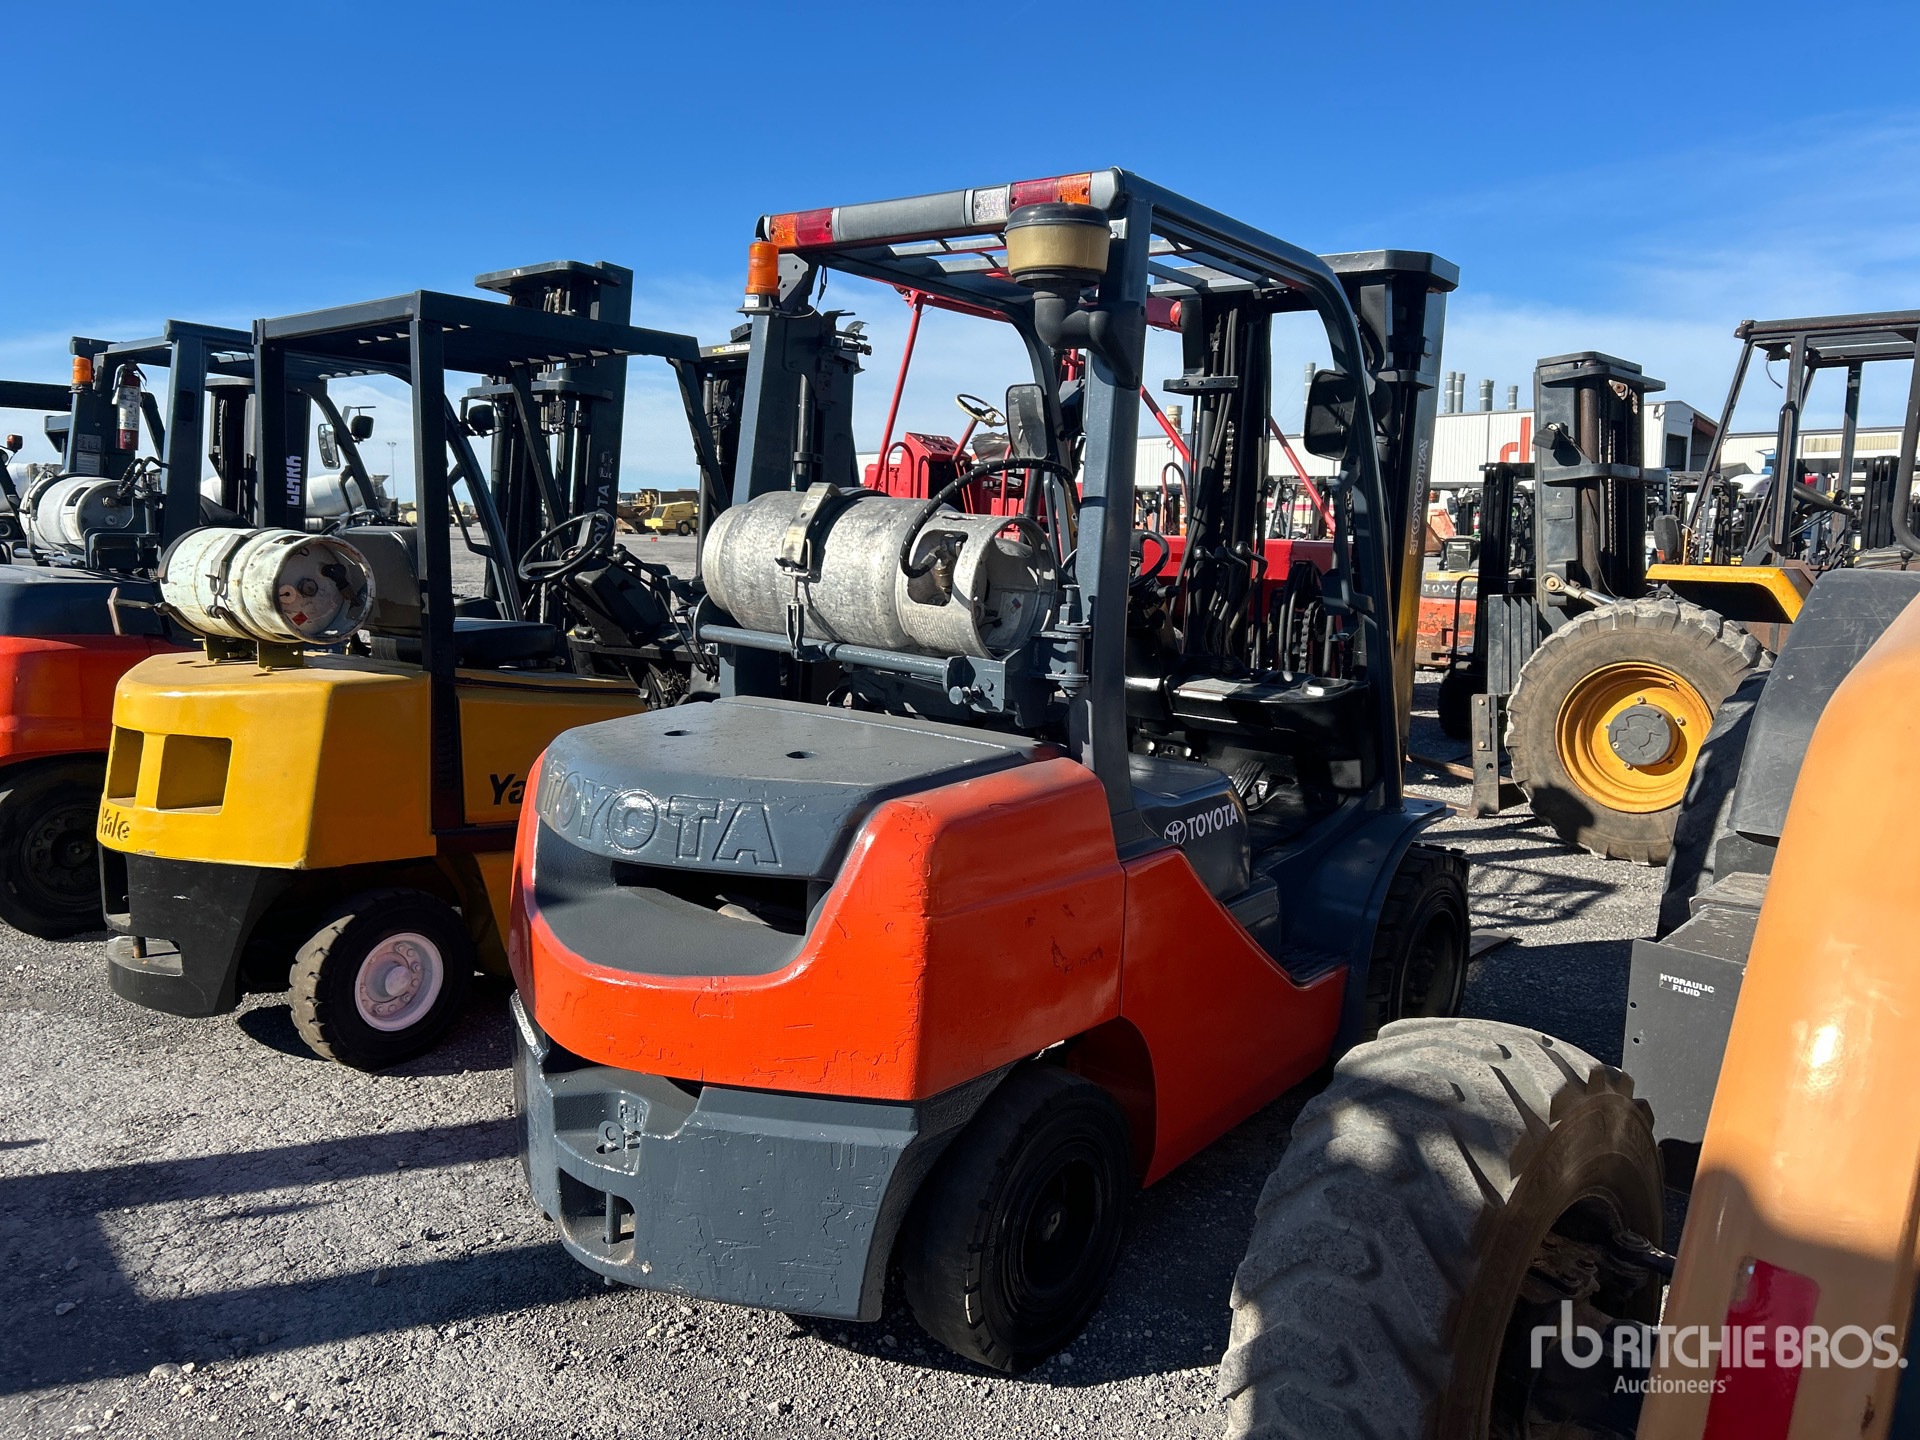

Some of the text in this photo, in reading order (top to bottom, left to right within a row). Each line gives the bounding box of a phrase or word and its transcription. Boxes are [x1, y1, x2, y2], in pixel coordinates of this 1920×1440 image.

[286, 455, 302, 506] CLARK
[100, 806, 131, 841] Yale
[543, 760, 783, 867] TOYOTA
[1187, 803, 1239, 840] TOYOTA
[1660, 972, 1715, 994] HYDRAULIC
[1672, 984, 1701, 997] FLUID
